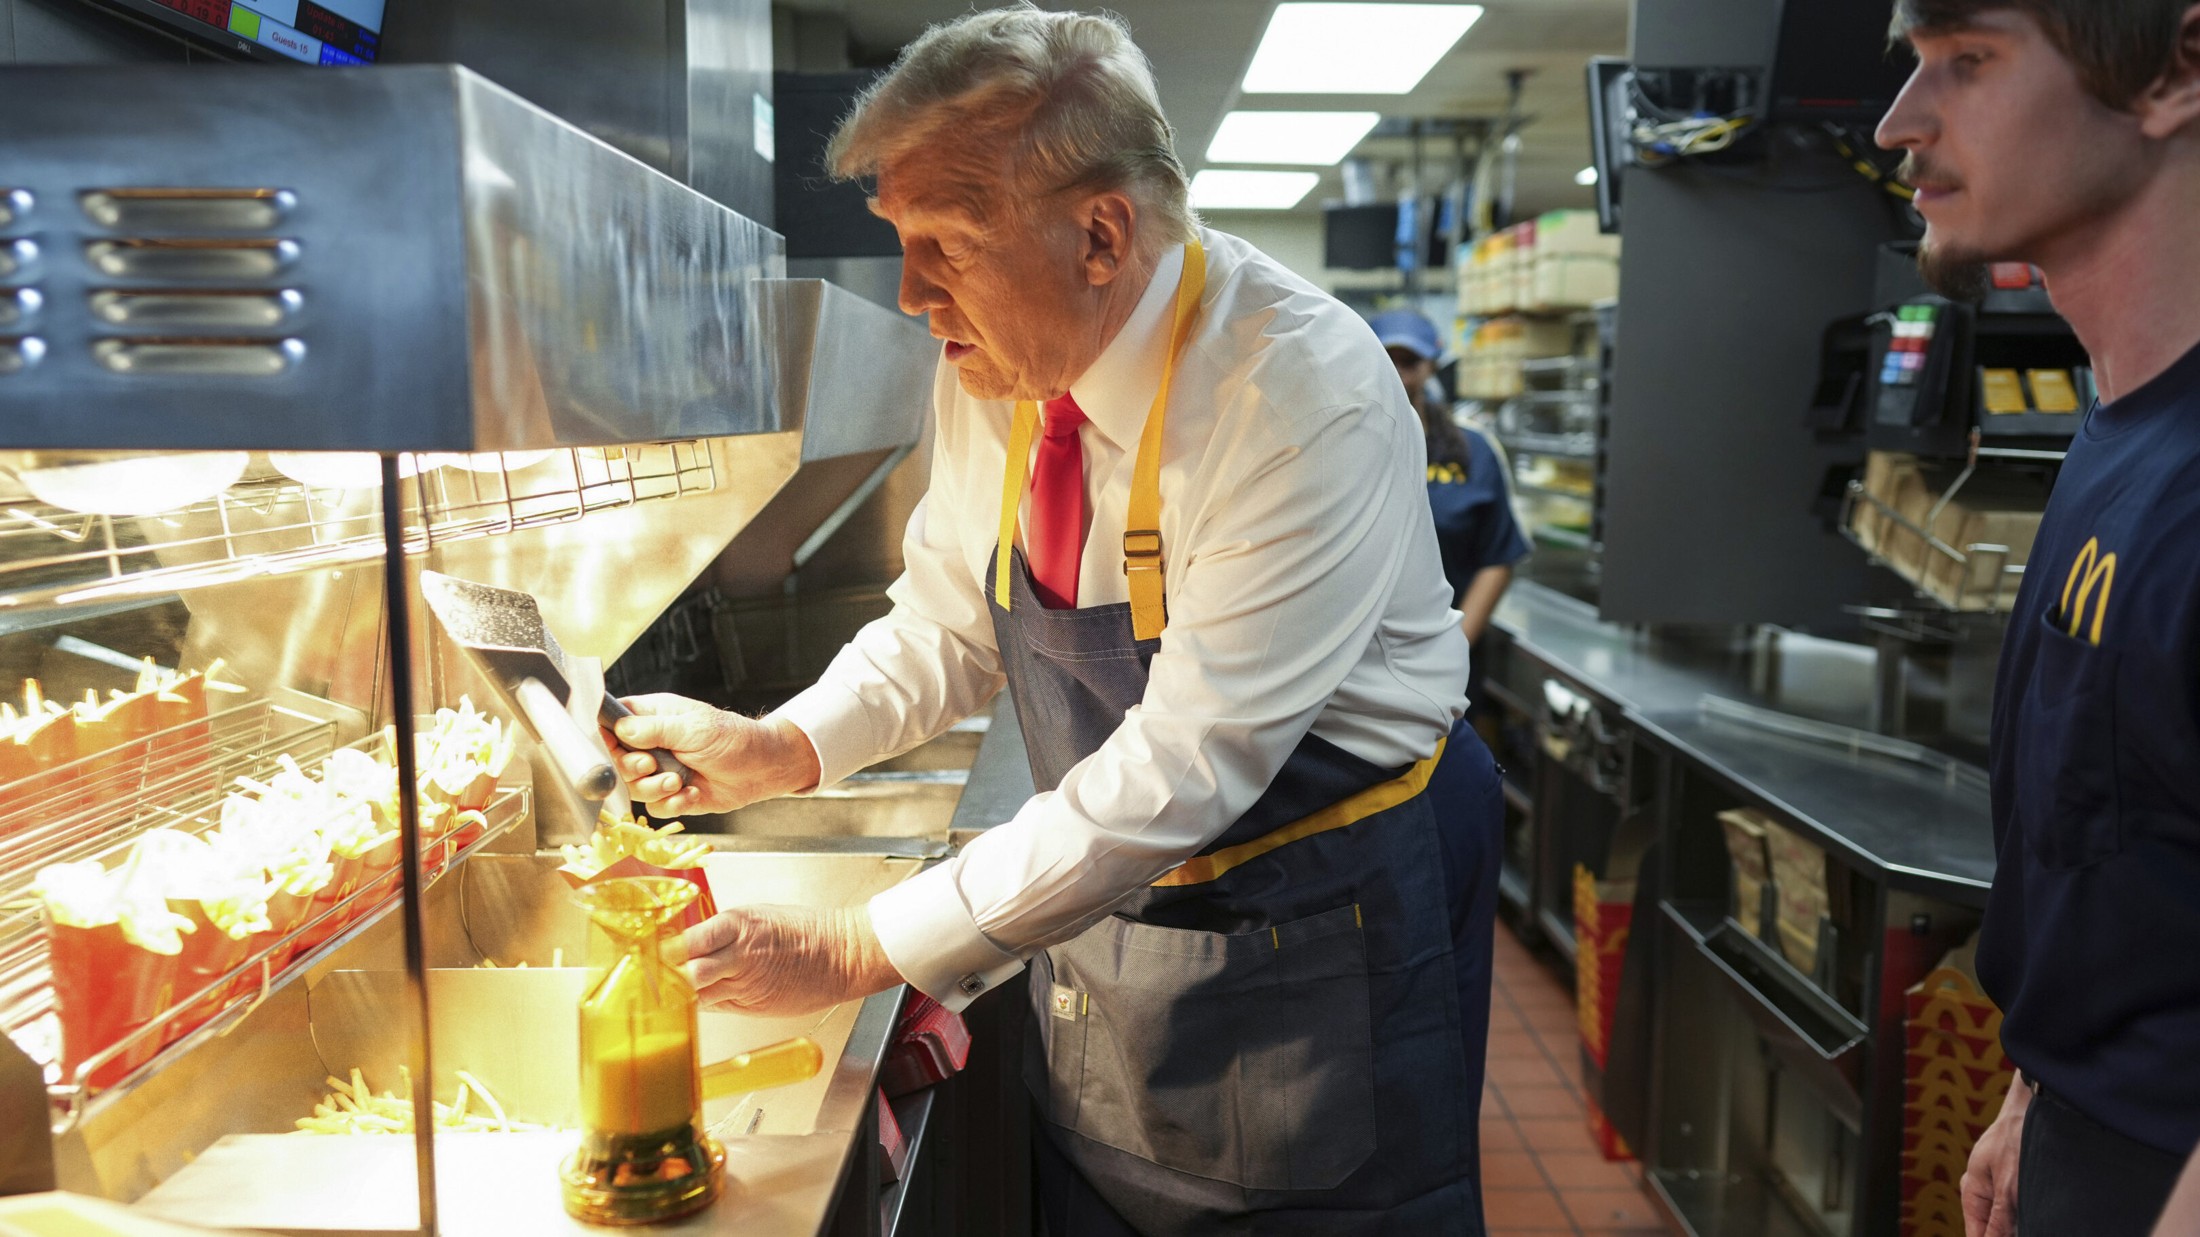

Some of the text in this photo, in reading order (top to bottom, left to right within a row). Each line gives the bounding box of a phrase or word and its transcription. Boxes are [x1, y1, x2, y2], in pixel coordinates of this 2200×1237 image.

[237, 40, 252, 54] DELL
[271, 31, 298, 50] Guests
[300, 43, 309, 55] 15
